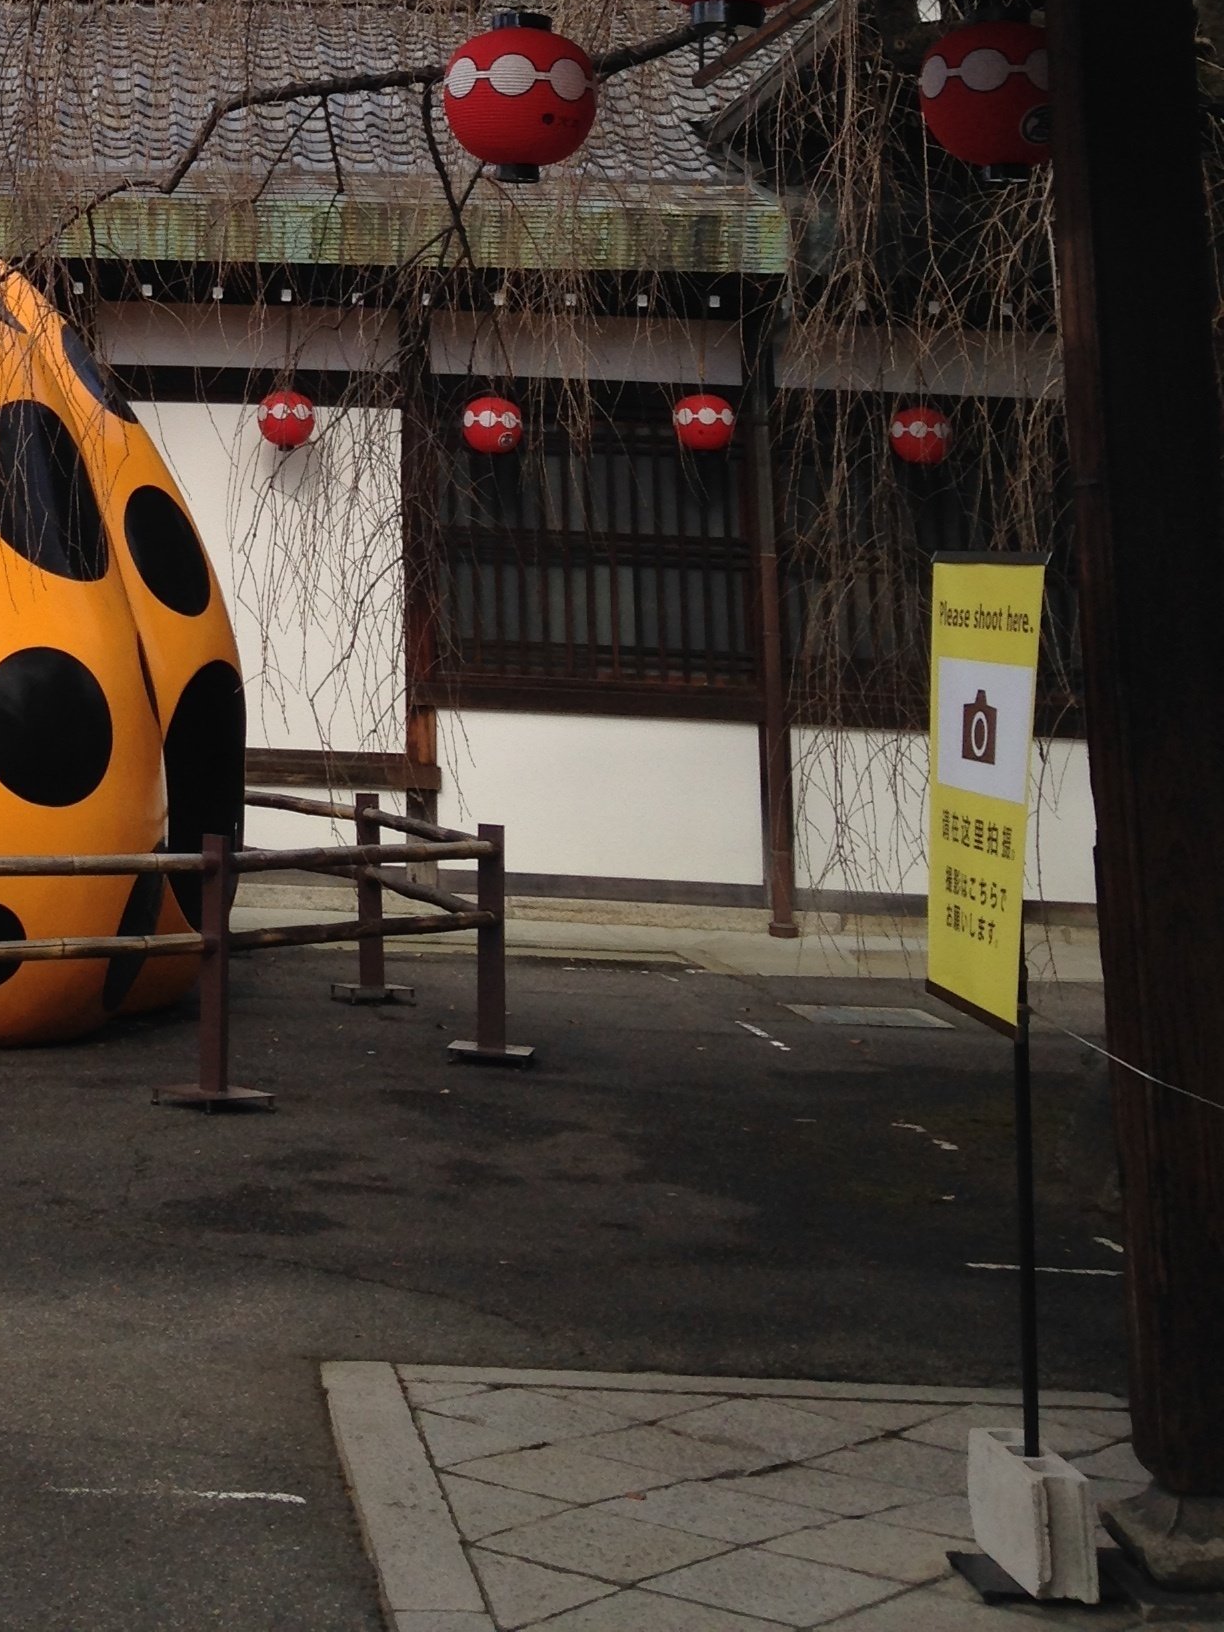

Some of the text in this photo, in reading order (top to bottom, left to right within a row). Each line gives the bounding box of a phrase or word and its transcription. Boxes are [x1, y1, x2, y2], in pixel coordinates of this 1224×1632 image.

[940, 601, 1033, 633] Please shoot here.
[946, 865, 1007, 912] 撮影はこちらで
[946, 904, 998, 948] お願いします。
